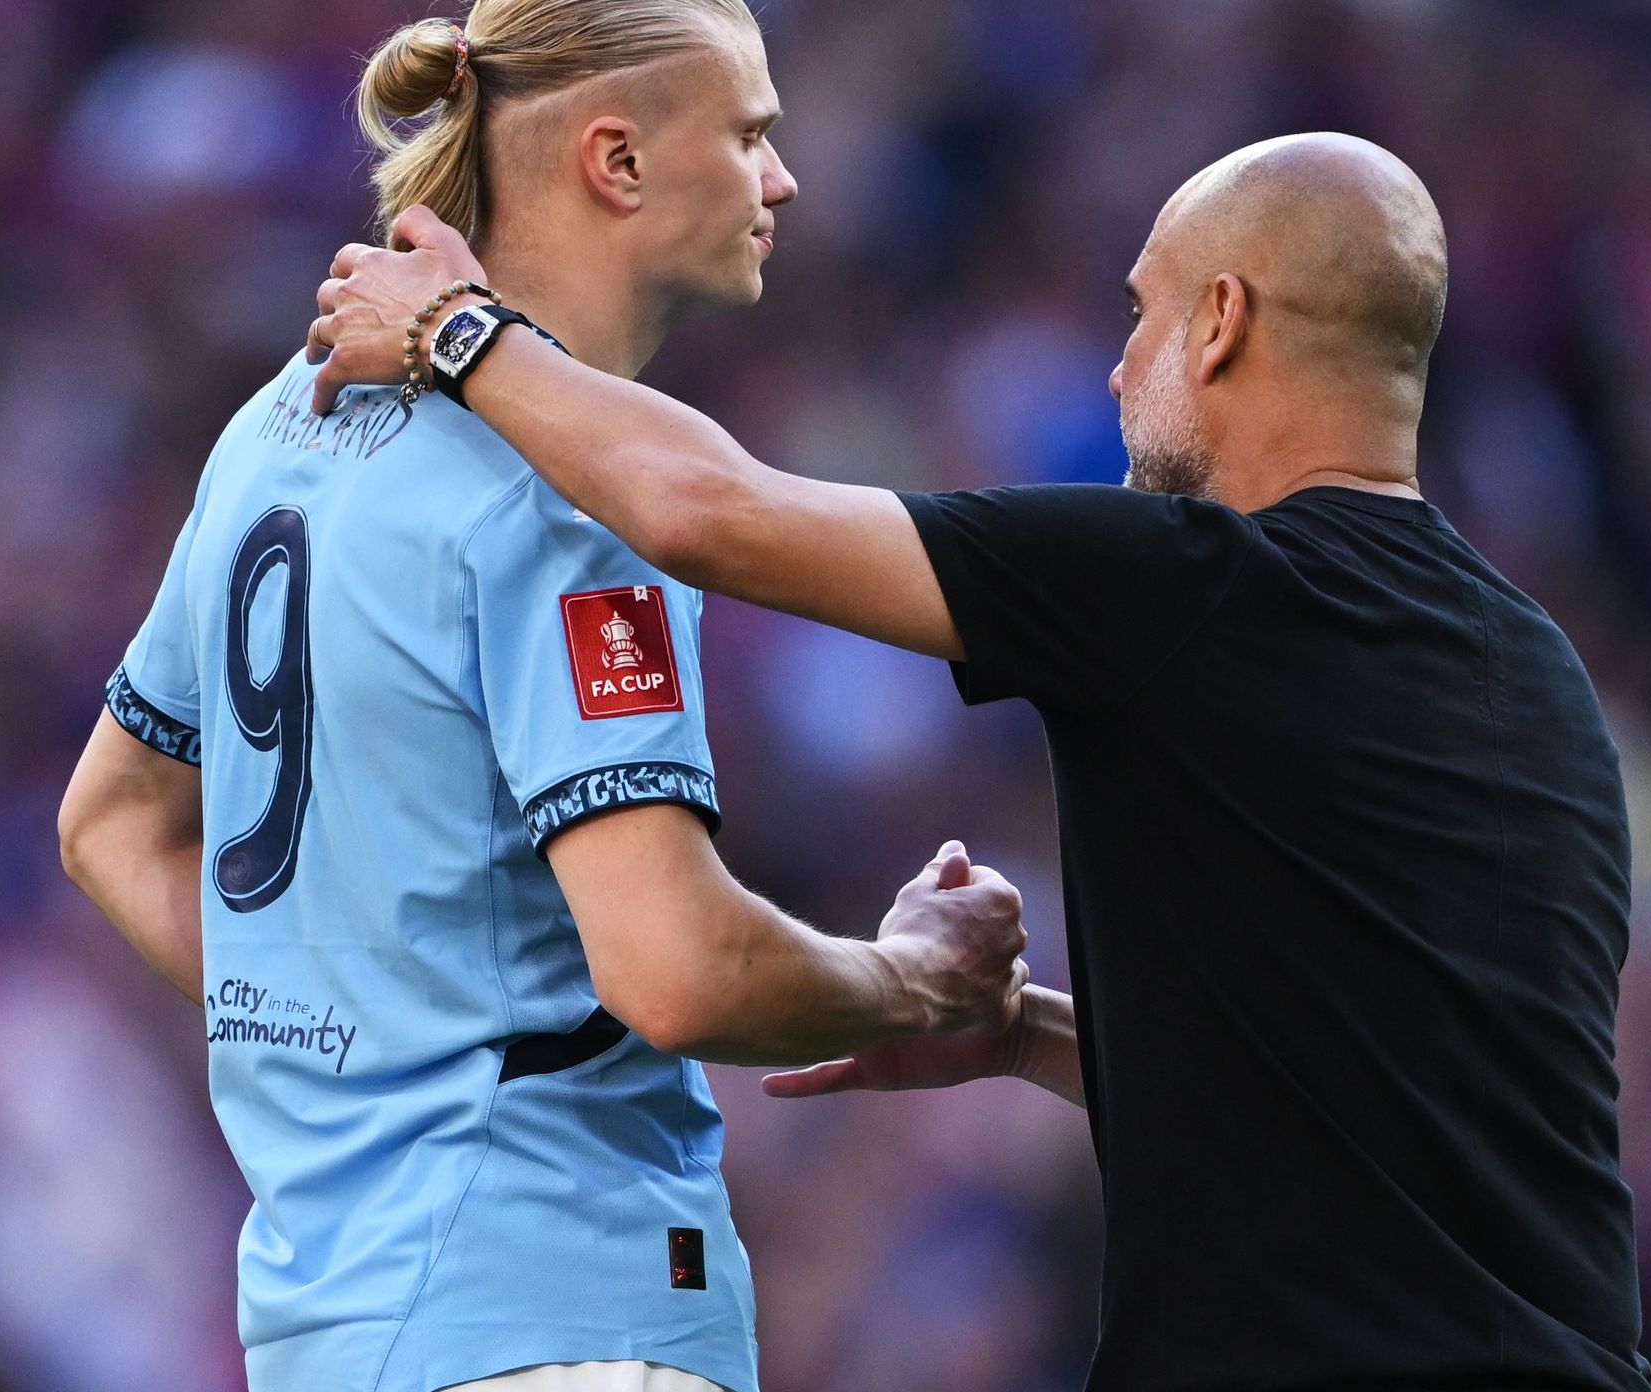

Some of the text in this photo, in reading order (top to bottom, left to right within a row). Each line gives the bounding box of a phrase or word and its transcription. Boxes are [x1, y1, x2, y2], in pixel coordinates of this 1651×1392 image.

[591, 673, 665, 698] FA CUP
[213, 503, 315, 914] 9
[219, 978, 310, 1014] City in the
